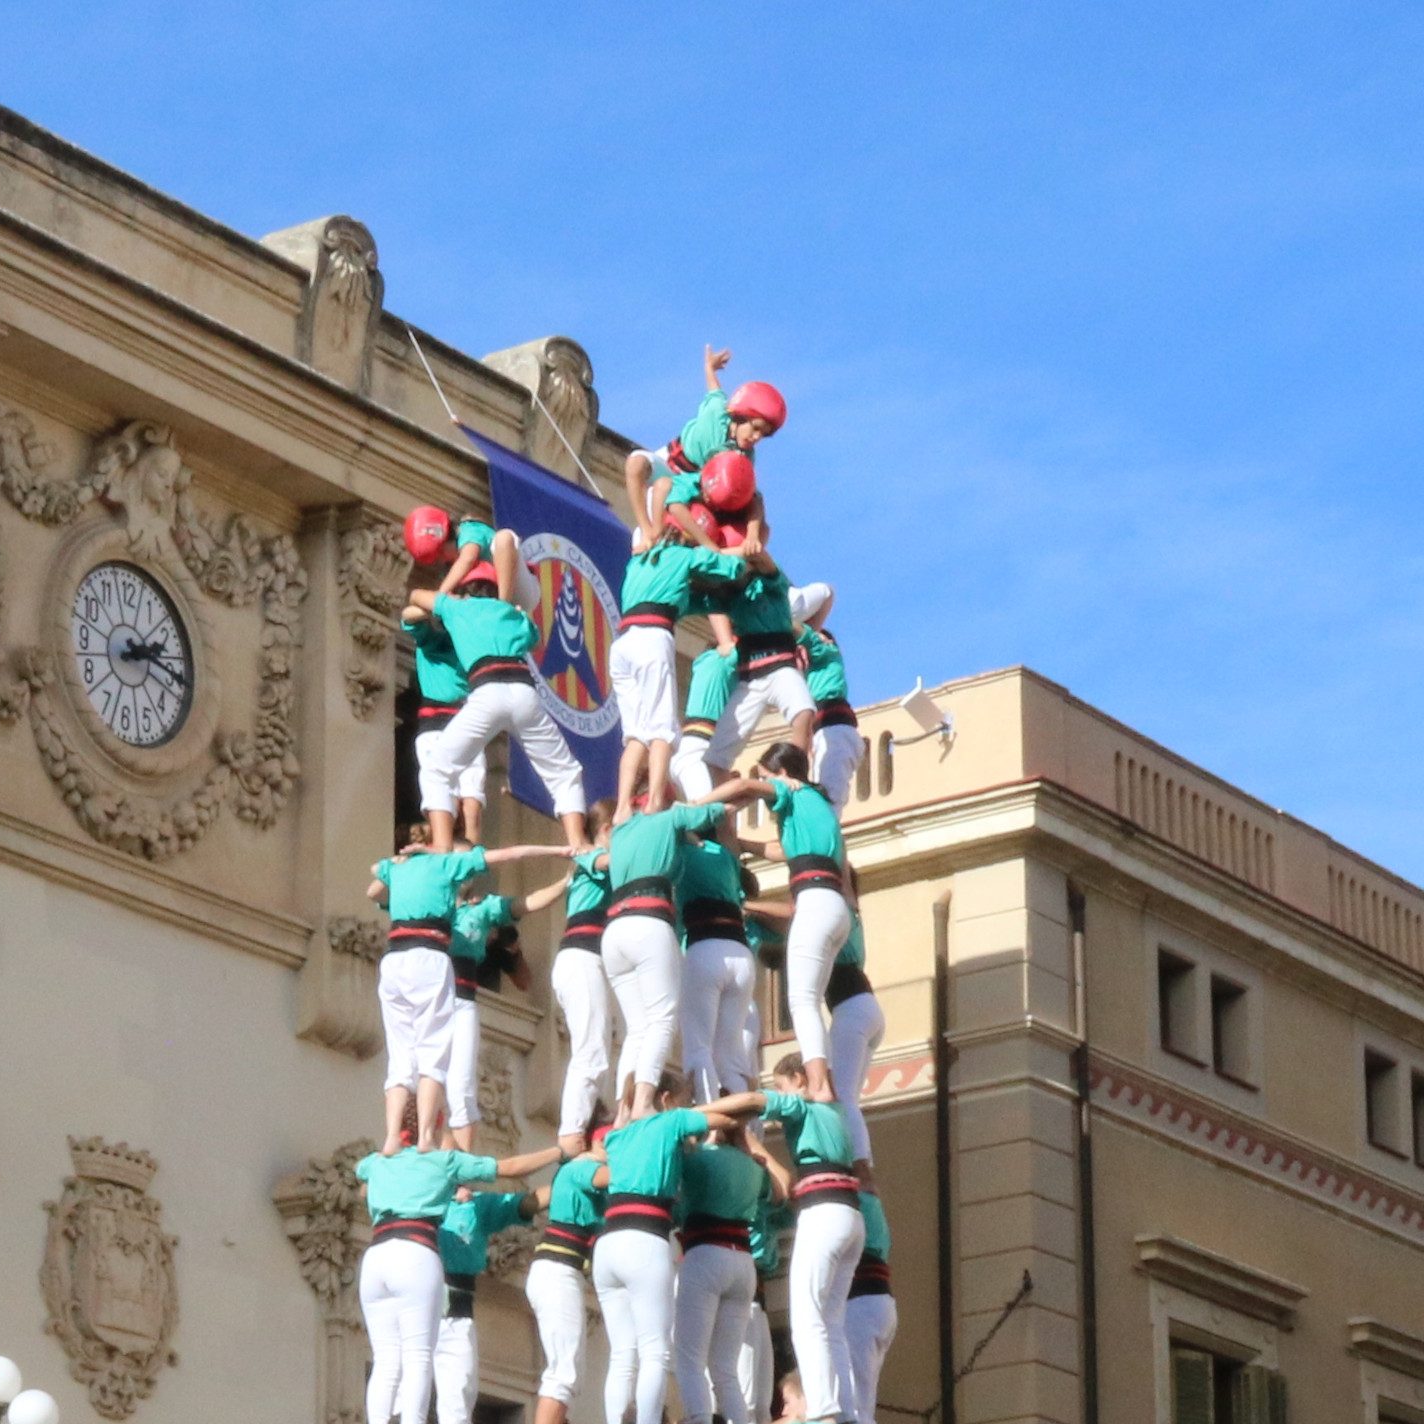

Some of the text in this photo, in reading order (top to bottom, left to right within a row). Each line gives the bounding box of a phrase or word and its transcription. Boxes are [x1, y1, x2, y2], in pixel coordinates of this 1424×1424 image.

[101, 580, 111, 606] 11
[123, 581, 136, 608] 12
[86, 595, 99, 622] 10
[80, 625, 89, 650] 9
[161, 627, 169, 653] 2
[85, 659, 94, 683] 8
[102, 690, 111, 715] 7
[157, 690, 165, 714] 4
[121, 706, 130, 730] 6
[142, 708, 151, 733] 5
